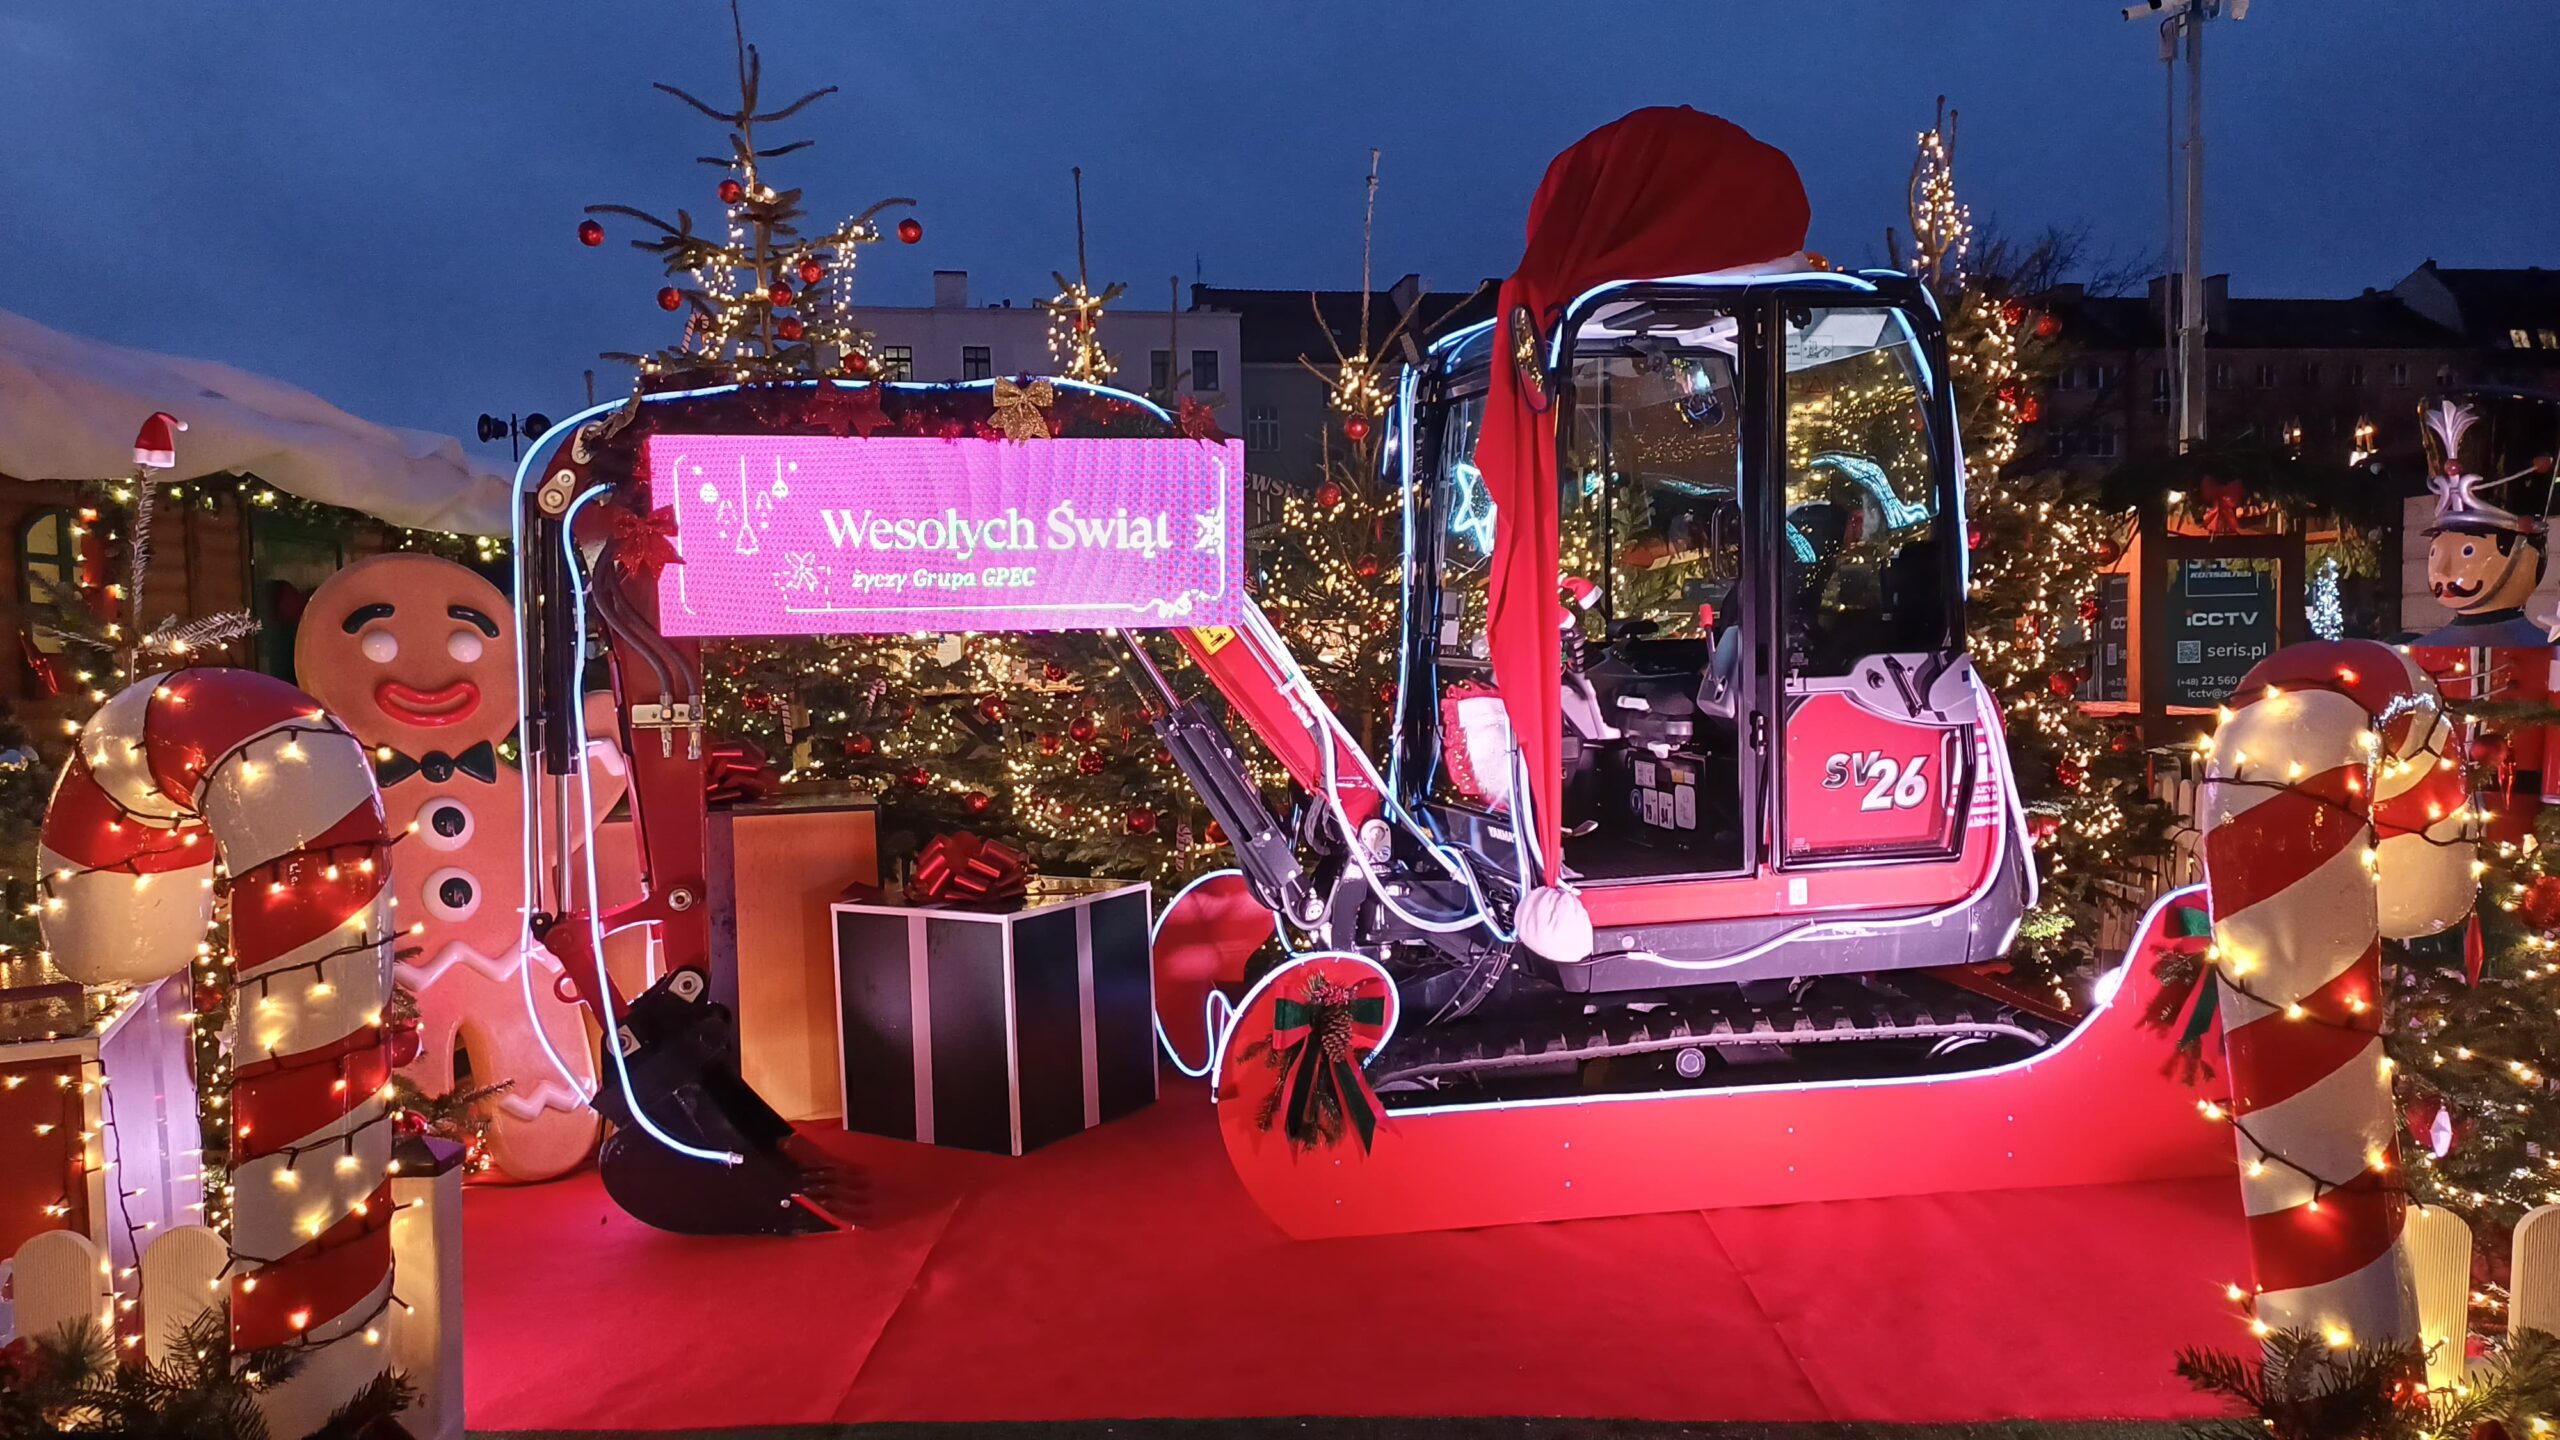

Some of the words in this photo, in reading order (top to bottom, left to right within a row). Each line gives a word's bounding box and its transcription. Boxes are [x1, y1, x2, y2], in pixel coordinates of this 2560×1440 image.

[1047, 500, 1173, 558] Świąt
[852, 569, 908, 593] życzy
[913, 568, 977, 590] Grupa
[982, 567, 1036, 588] GPEC
[2186, 610, 2258, 626] iCCTV
[2207, 642, 2267, 660] seris.pl
[2177, 678, 2199, 687] (+48)
[2201, 676, 2214, 685] 22
[2217, 676, 2237, 685] 560
[1820, 750, 1932, 813] SV26
